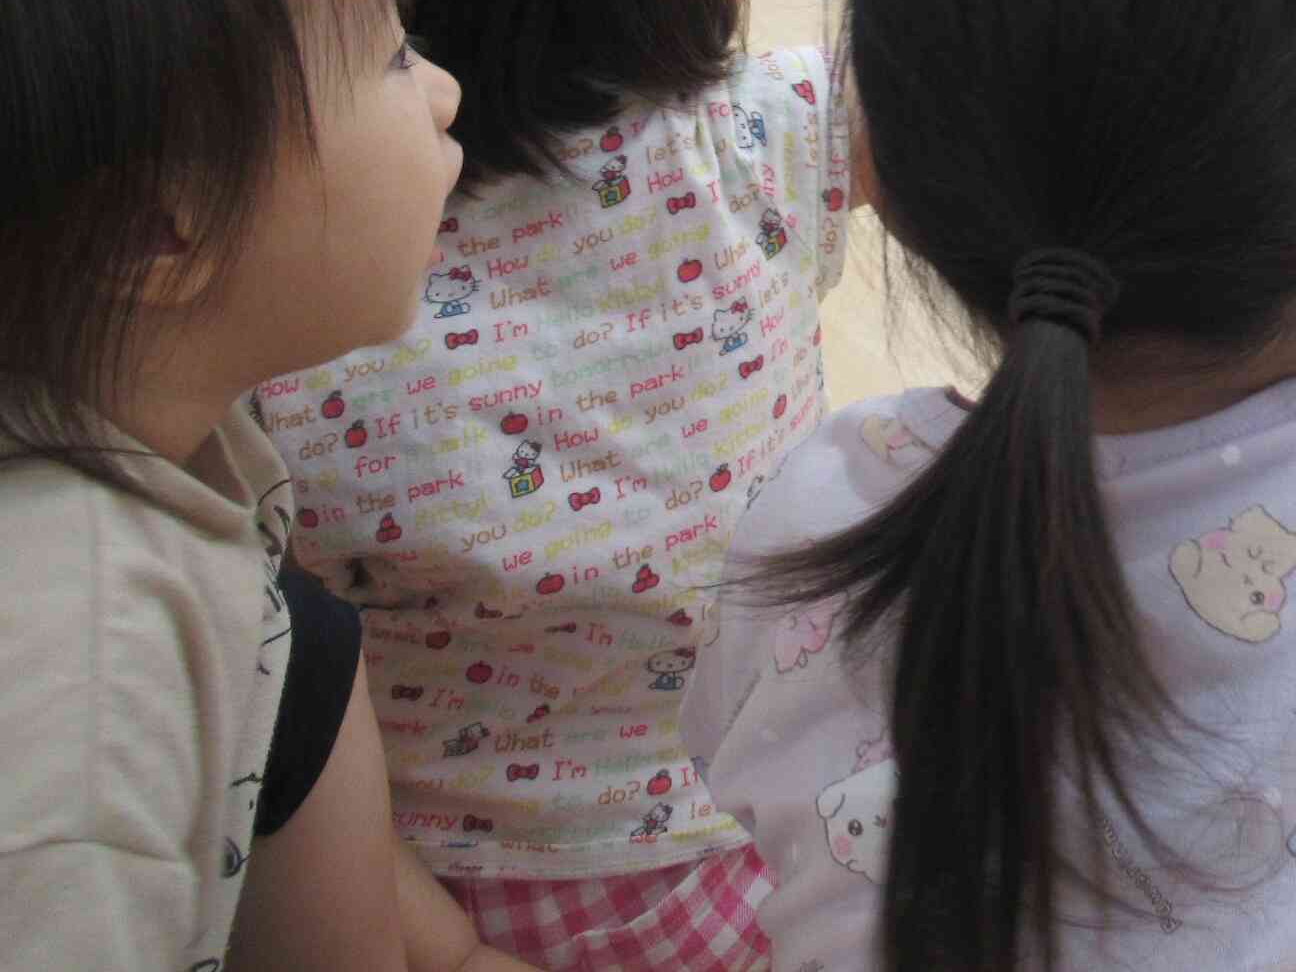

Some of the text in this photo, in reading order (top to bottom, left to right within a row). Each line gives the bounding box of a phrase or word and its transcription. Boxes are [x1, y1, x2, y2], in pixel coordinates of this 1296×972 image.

[606, 250, 642, 274] we
[404, 374, 438, 397] we
[572, 322, 615, 351] do?
[494, 320, 530, 344] I'm
[298, 430, 340, 461] do?
[373, 411, 402, 440] If
[467, 378, 543, 413] sunny
[353, 454, 398, 481] for
[575, 387, 620, 414] the
[553, 427, 600, 453] How
[643, 397, 687, 426] you
[560, 450, 624, 483] What
[680, 418, 711, 439] we
[460, 523, 509, 553] you
[613, 476, 649, 501] I'm
[501, 548, 535, 572] we
[664, 478, 704, 512] do?
[619, 722, 650, 741] we
[598, 779, 642, 806] do?
